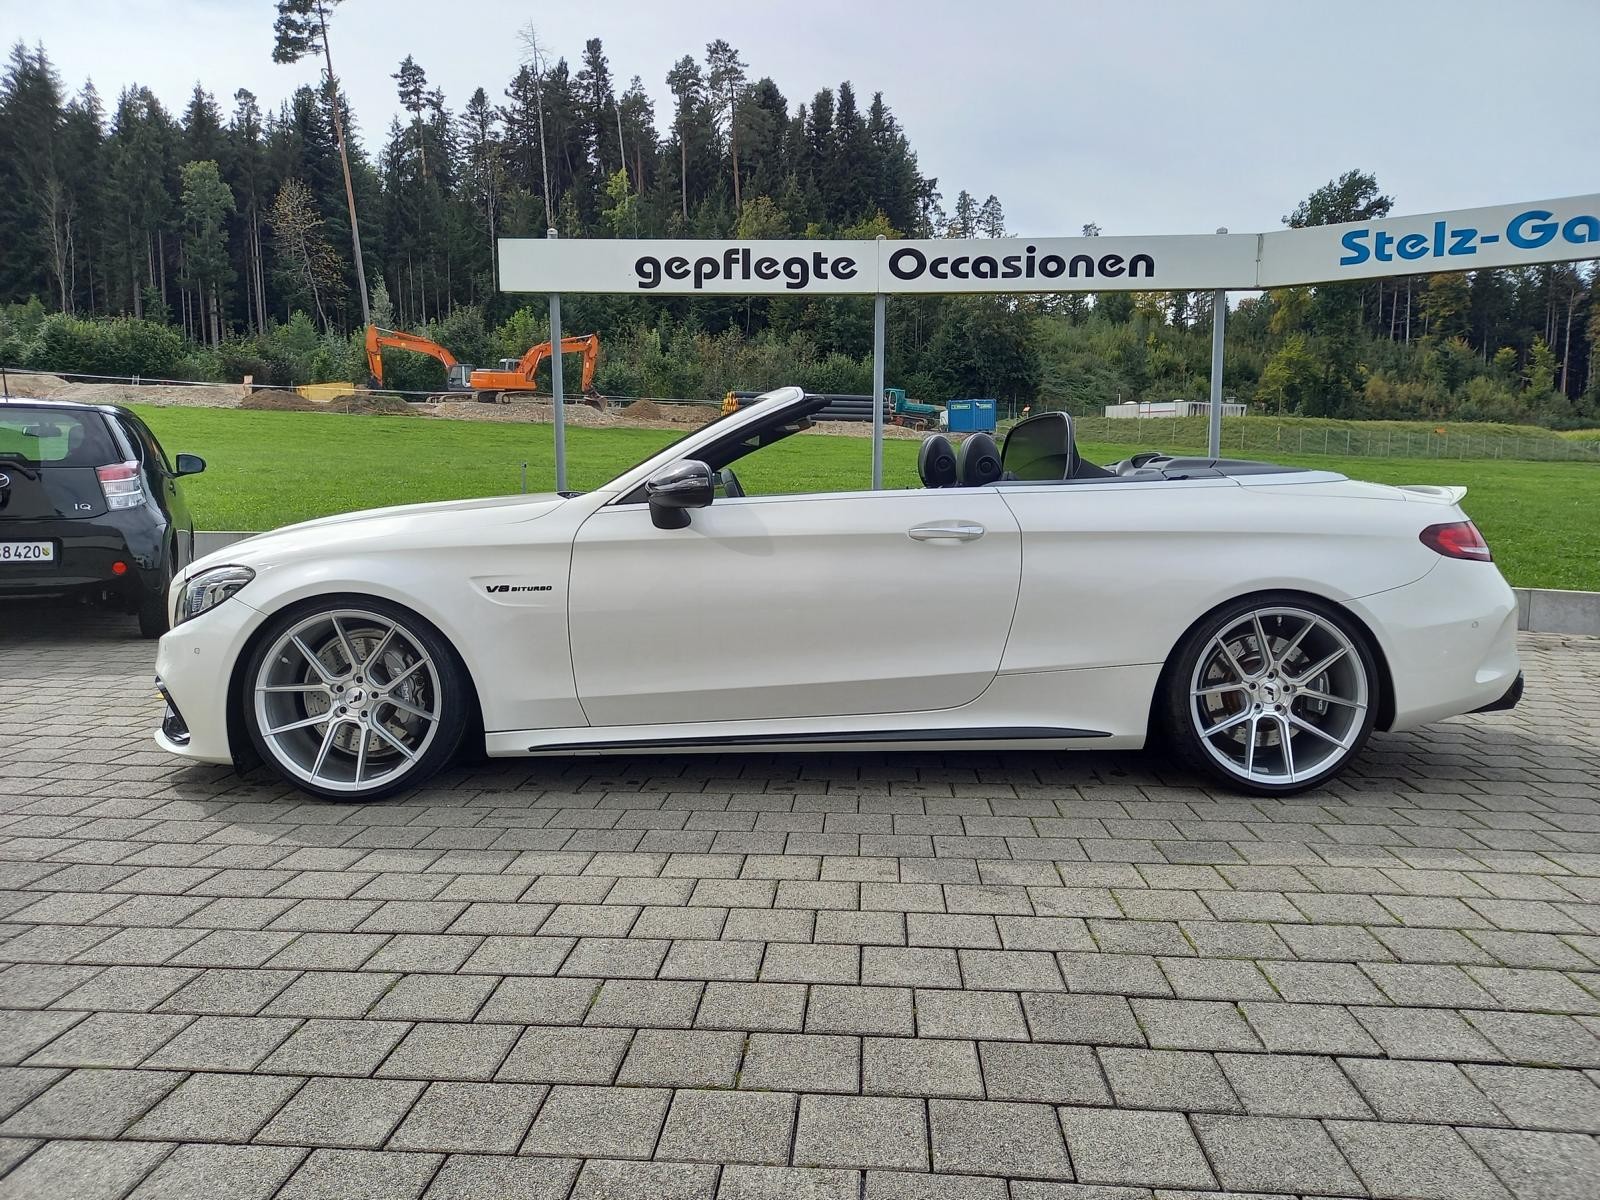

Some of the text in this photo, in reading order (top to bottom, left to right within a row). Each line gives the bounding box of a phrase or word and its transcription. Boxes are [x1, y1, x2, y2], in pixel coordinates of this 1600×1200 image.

[1339, 209, 1600, 267] Stelz-Ga
[634, 245, 1155, 289] gepflegte Occasionen
[0, 545, 41, 559] 8420
[486, 585, 510, 593] V8
